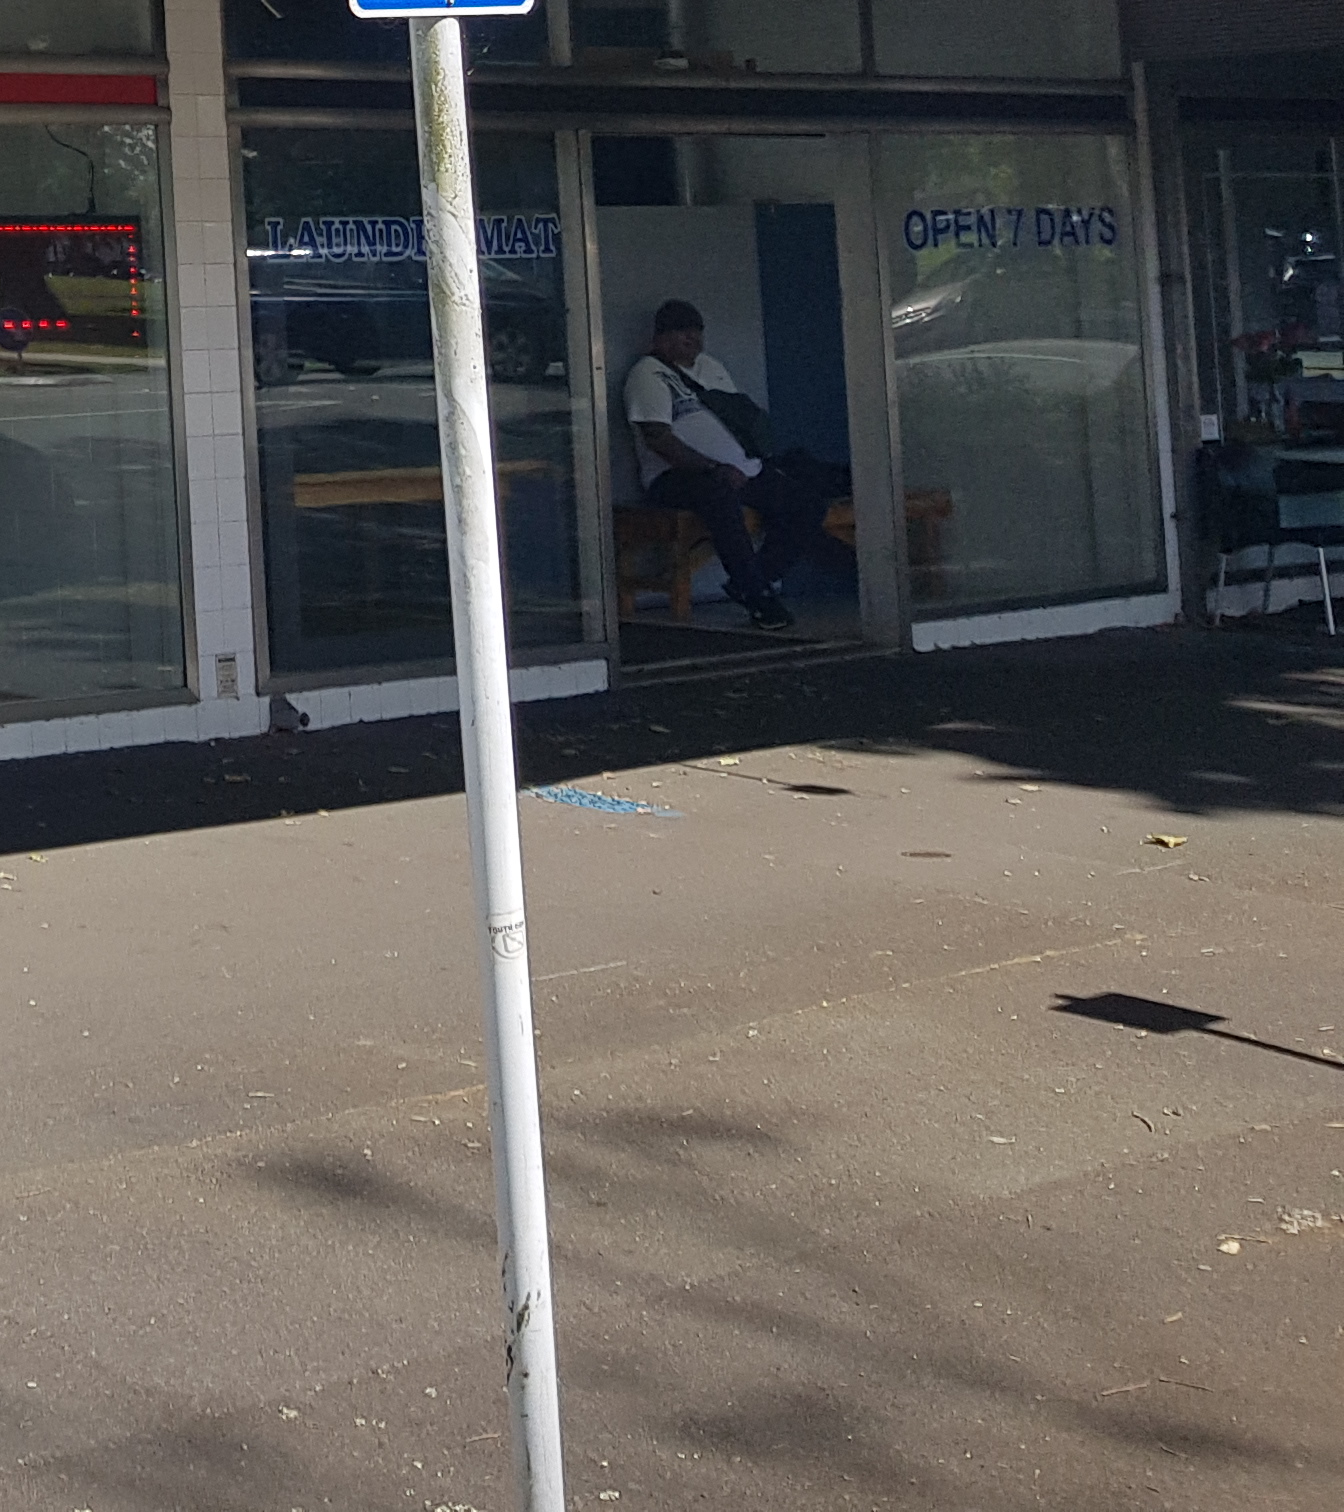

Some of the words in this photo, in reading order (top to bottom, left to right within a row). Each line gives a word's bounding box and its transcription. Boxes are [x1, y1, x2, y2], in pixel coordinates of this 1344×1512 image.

[265, 215, 560, 264] LAUNDMAT
[904, 207, 997, 250] OPEN
[1008, 207, 1024, 246] 7
[1035, 207, 1117, 246] DAYS
